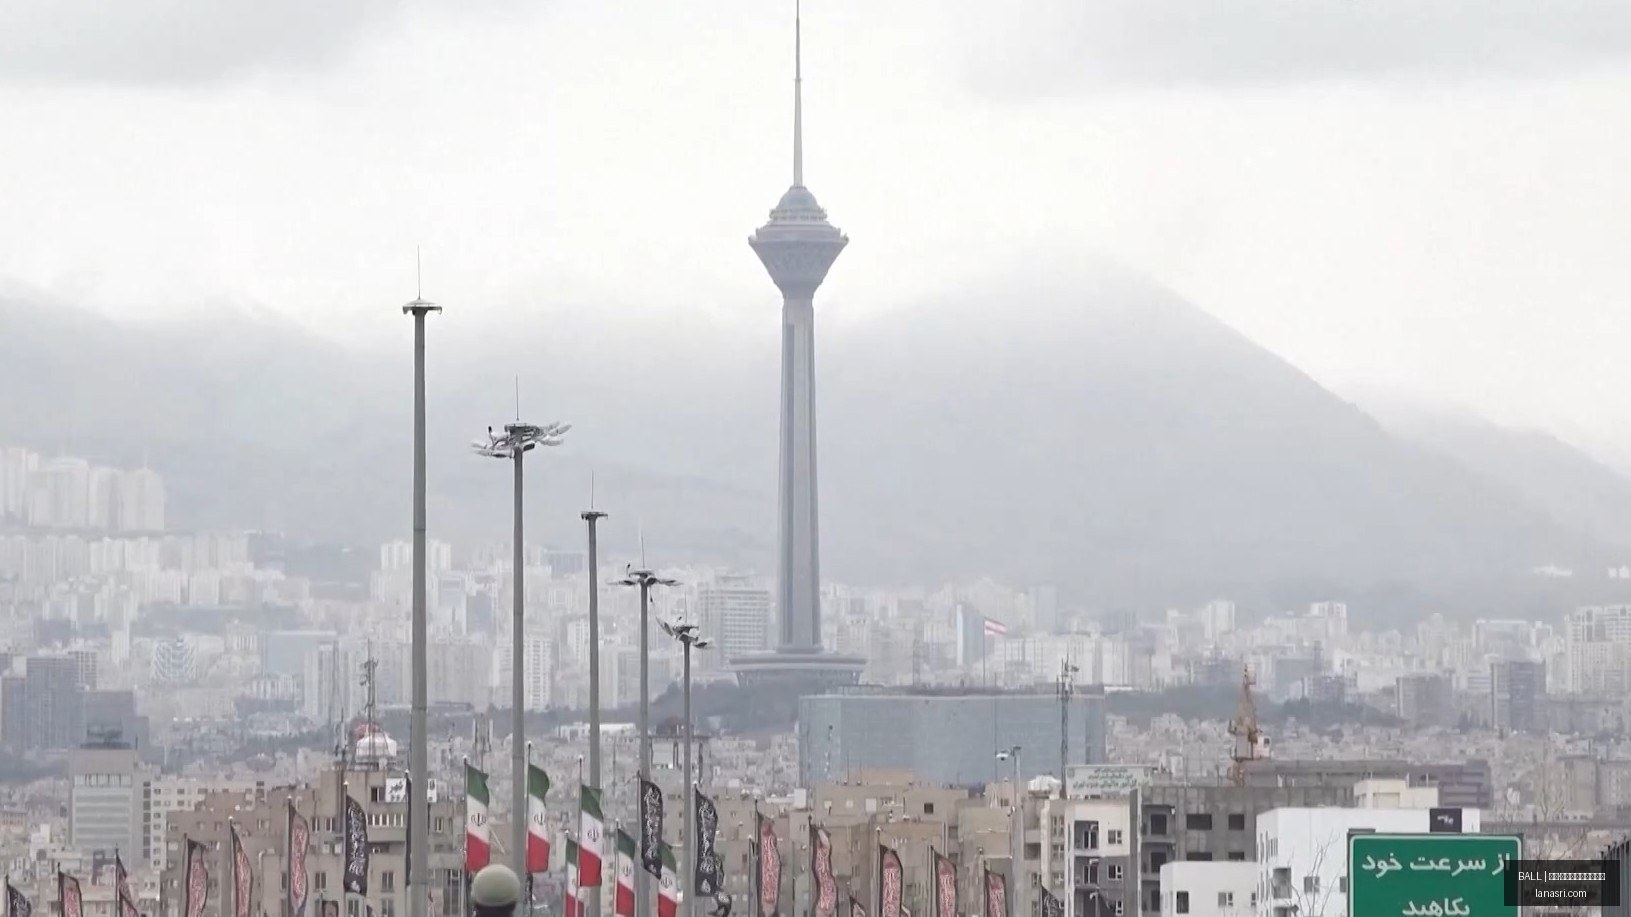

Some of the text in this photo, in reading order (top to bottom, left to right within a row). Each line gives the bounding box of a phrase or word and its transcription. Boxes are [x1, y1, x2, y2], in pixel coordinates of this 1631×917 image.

[1361, 852, 1510, 879] از سرعت خود
